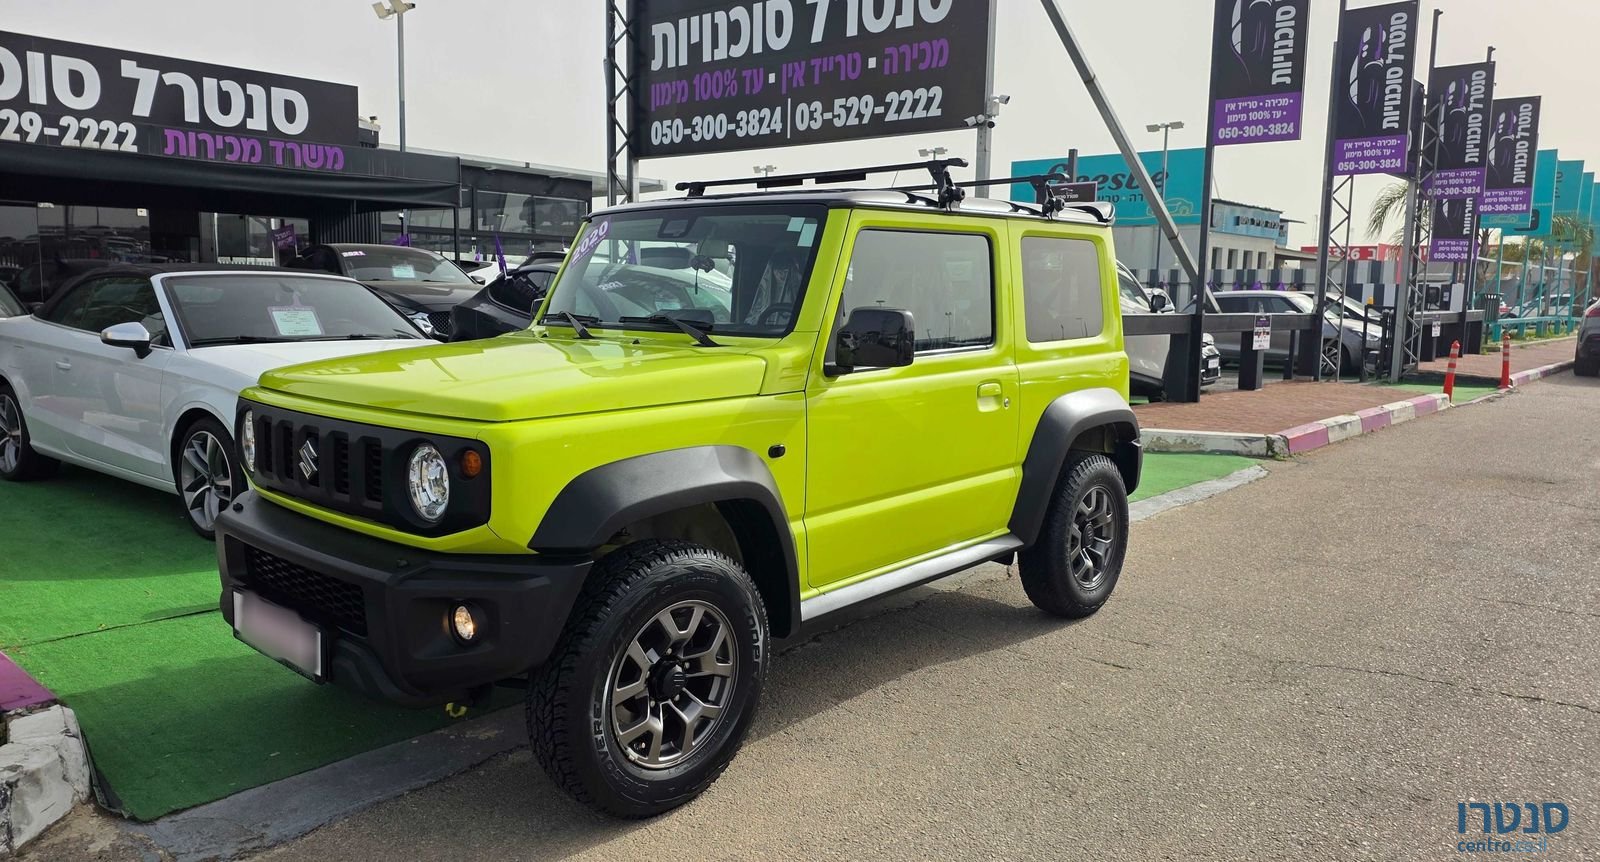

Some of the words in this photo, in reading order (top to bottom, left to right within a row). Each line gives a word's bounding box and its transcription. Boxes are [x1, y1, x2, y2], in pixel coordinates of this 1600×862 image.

[650, 0, 794, 71] סוכנויות
[1271, 5, 1297, 85] סוכנויות
[1386, 12, 1408, 64] סנטרל
[810, 51, 862, 85] טרייד
[883, 38, 950, 75] מכירה
[650, 76, 689, 112] מימון
[693, 68, 738, 102] 100%
[742, 67, 765, 95] עד
[780, 60, 806, 95] אין
[1468, 70, 1486, 112] סנטרל
[120, 58, 309, 135] סנטרל
[1225, 103, 1236, 113] אין
[1238, 101, 1258, 110] טרייד
[1265, 98, 1289, 107] מכירה
[1382, 66, 1404, 129] סוכנויות
[650, 106, 783, 146] 050-300-3824
[795, 86, 944, 131] 03-529-2222
[1218, 122, 1294, 139] 050-300-3824
[1227, 113, 1247, 124] מימון
[1249, 110, 1271, 120] 100%
[1272, 110, 1282, 119] עד
[1516, 103, 1533, 139] סנטרל
[164, 128, 263, 164] מכירות
[269, 140, 345, 170] משרד
[1363, 149, 1381, 157] 100%
[1465, 113, 1483, 163] סוכנויות
[1338, 158, 1401, 171] 050-300-3824
[1513, 140, 1530, 184] סוכנויות
[1479, 204, 1527, 212] 050-300-3824
[571, 221, 608, 263] 2020
